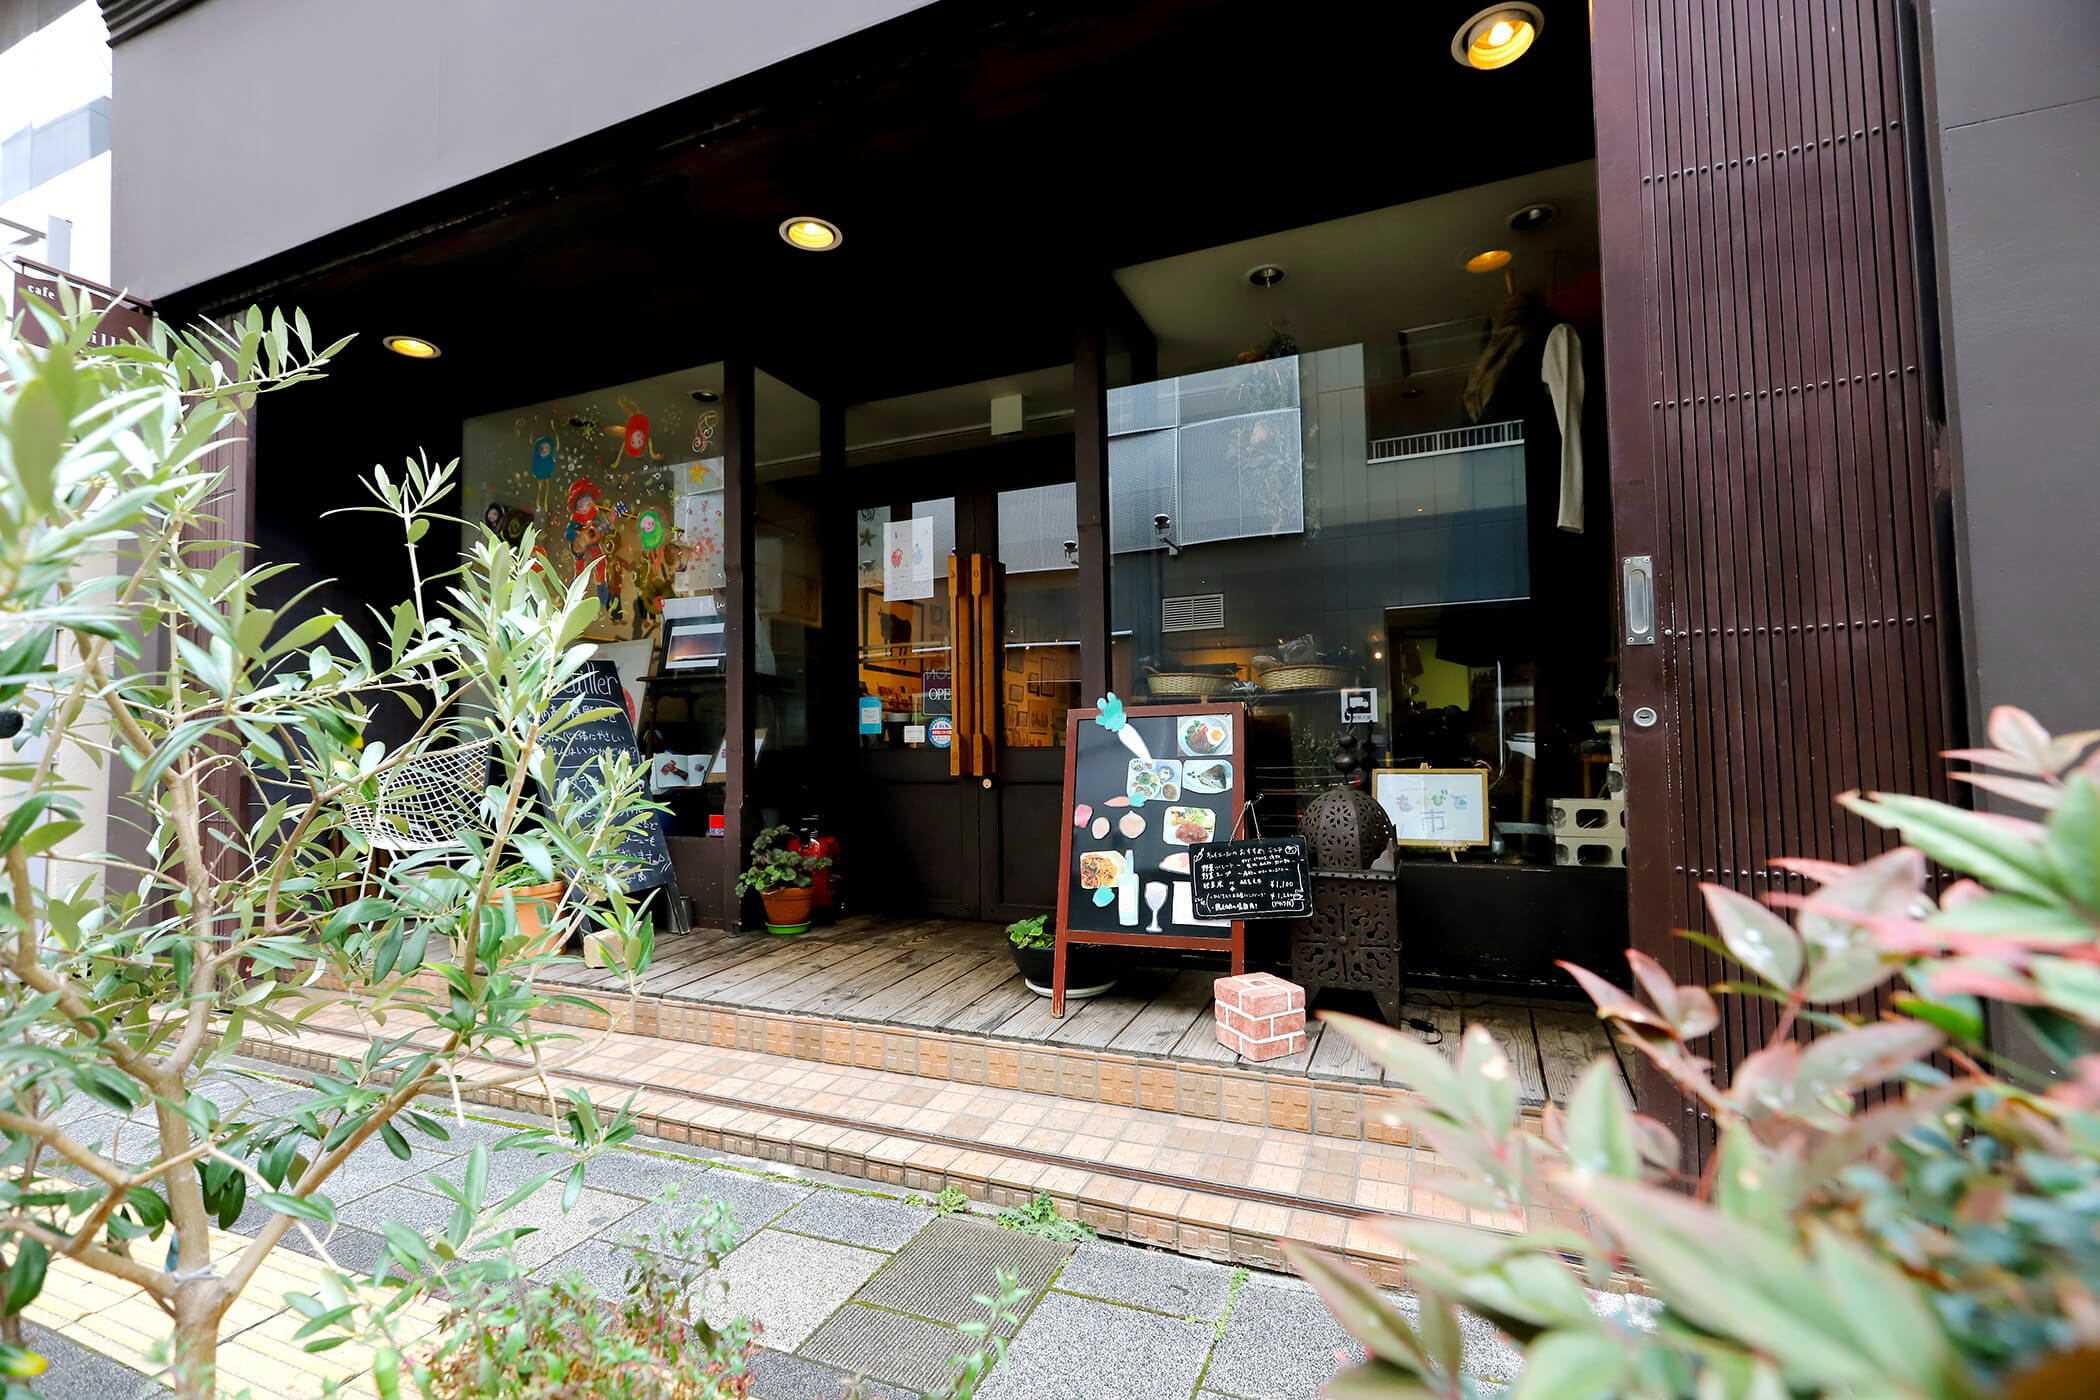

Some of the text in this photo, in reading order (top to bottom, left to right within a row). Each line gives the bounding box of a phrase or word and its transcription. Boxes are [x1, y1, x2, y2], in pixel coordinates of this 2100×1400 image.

[27, 284, 56, 300] cafe
[928, 687, 953, 701] OPE
[1420, 808, 1447, 833] 市
